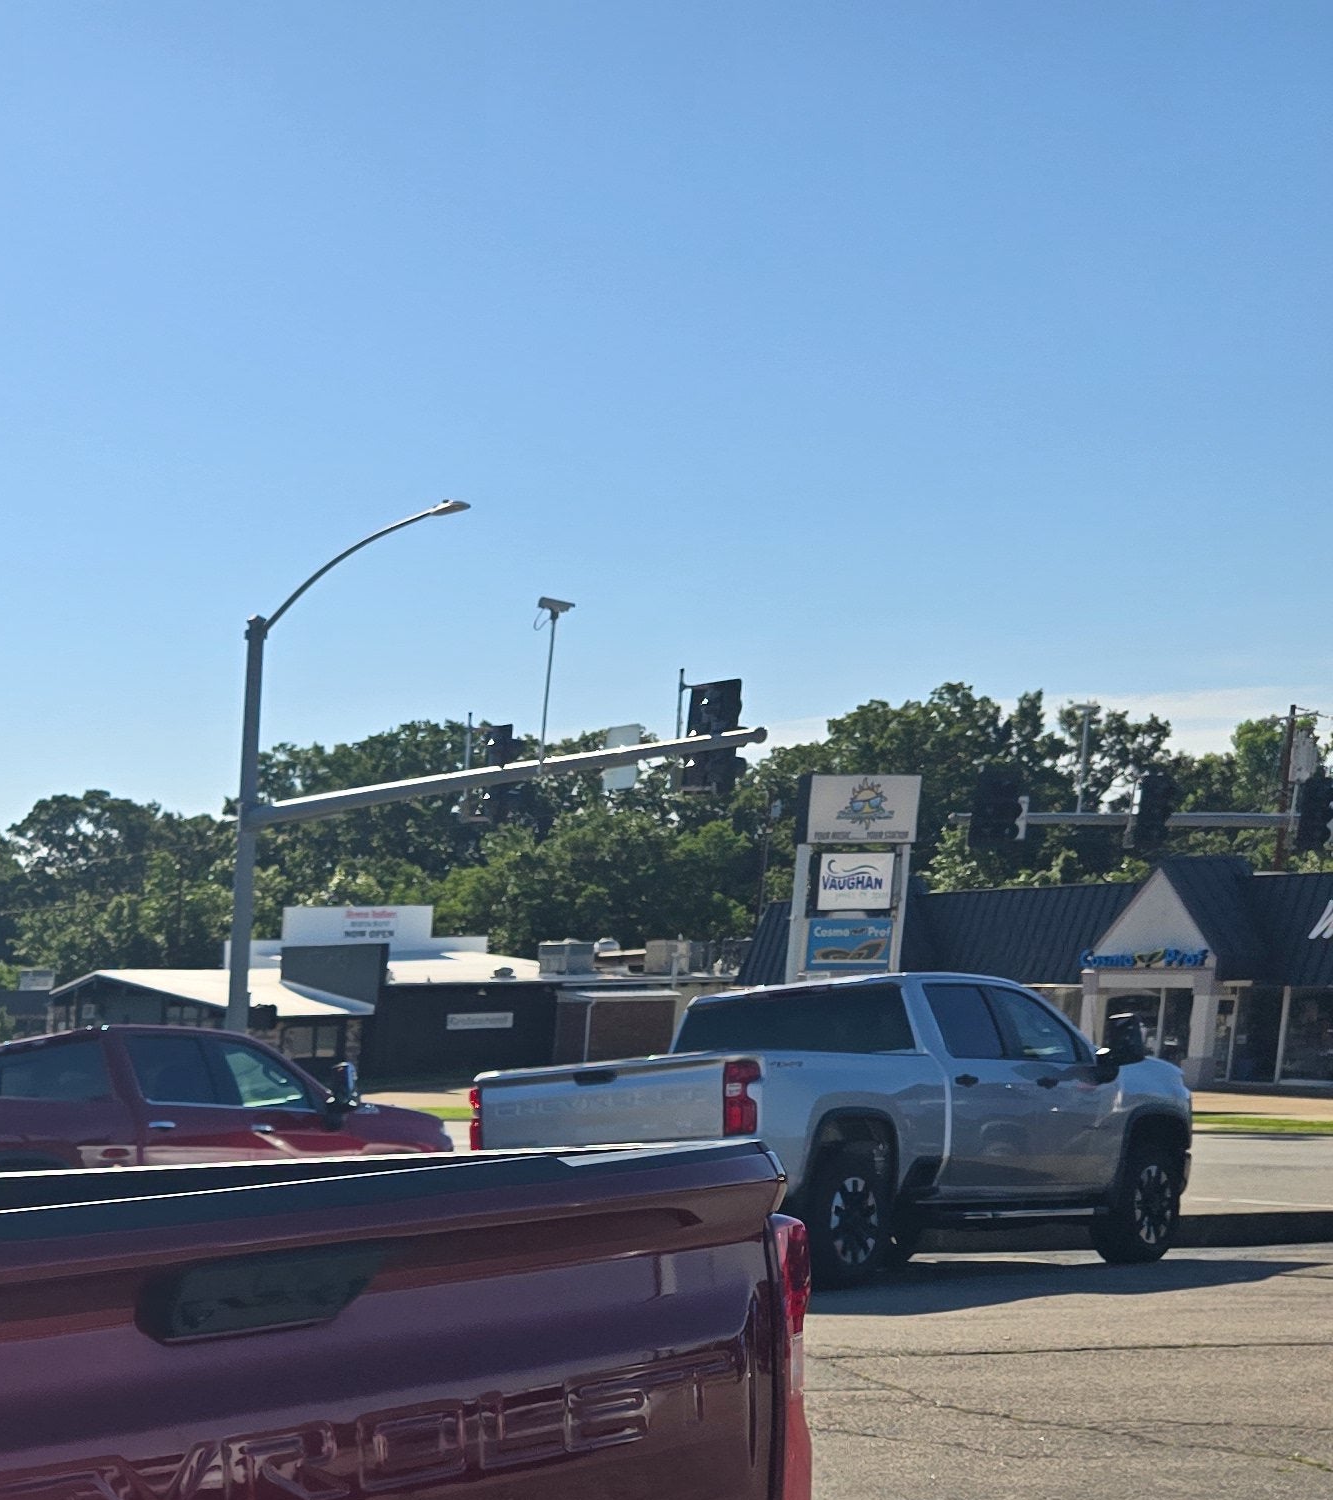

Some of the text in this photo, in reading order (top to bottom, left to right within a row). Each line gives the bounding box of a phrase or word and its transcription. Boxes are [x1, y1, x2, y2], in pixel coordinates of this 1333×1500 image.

[822, 876, 883, 891] VAUGHAN
[814, 926, 891, 937] Cosmo Prof
